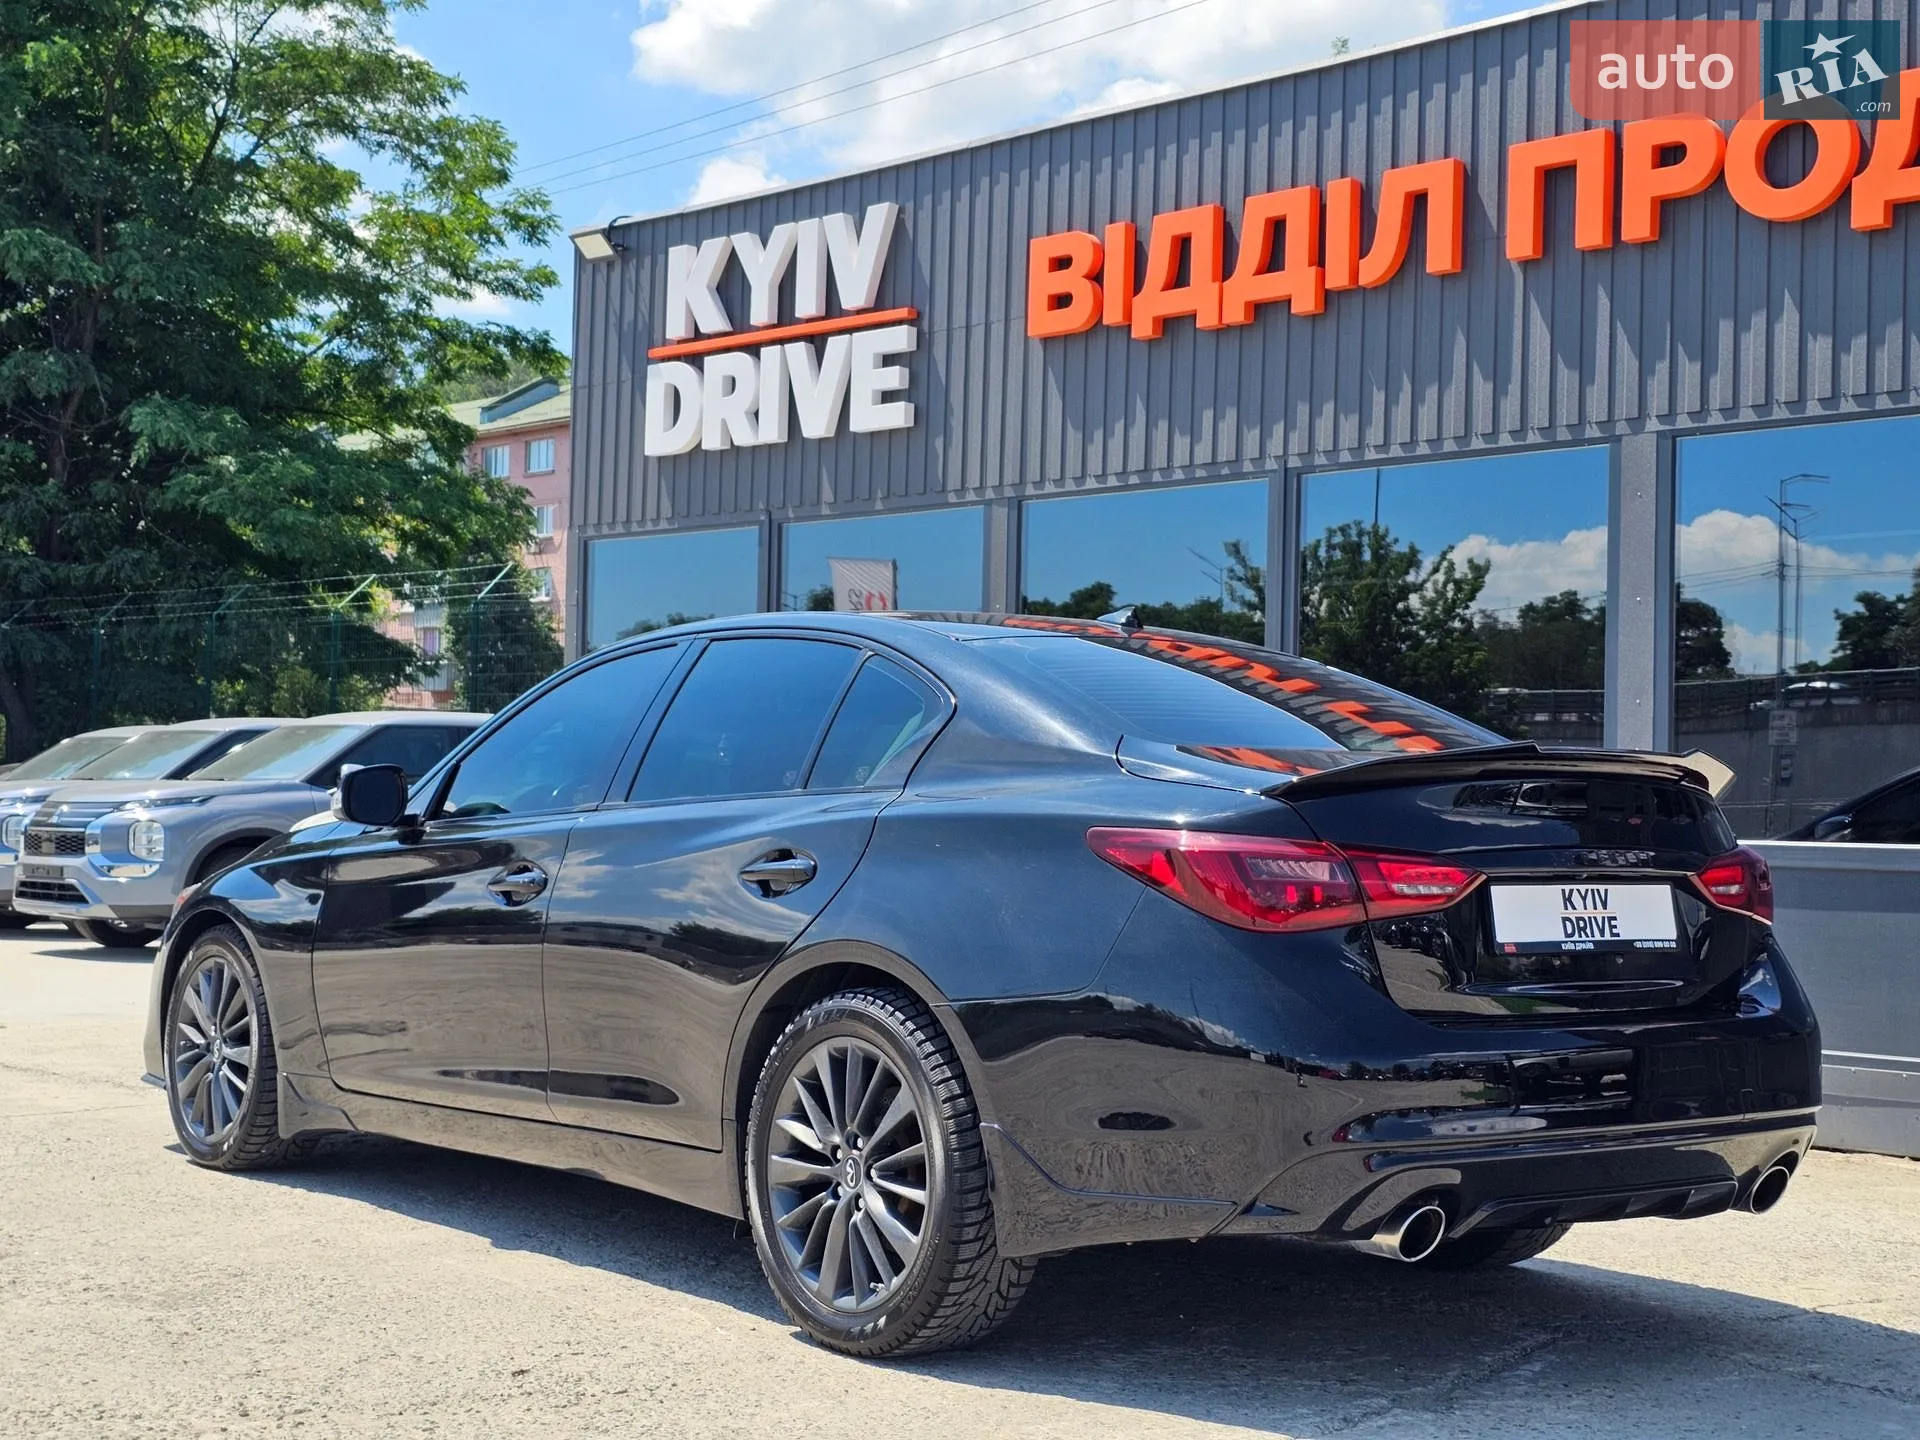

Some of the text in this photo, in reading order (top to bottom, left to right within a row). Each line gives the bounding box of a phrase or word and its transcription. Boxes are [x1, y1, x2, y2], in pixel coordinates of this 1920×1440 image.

[665, 202, 900, 341] KYIV
[1027, 158, 1464, 340] ВІДДІЛ
[644, 325, 917, 457] DRIVE
[1561, 888, 1609, 911] KYIV
[1561, 915, 1621, 938] DRIVE
